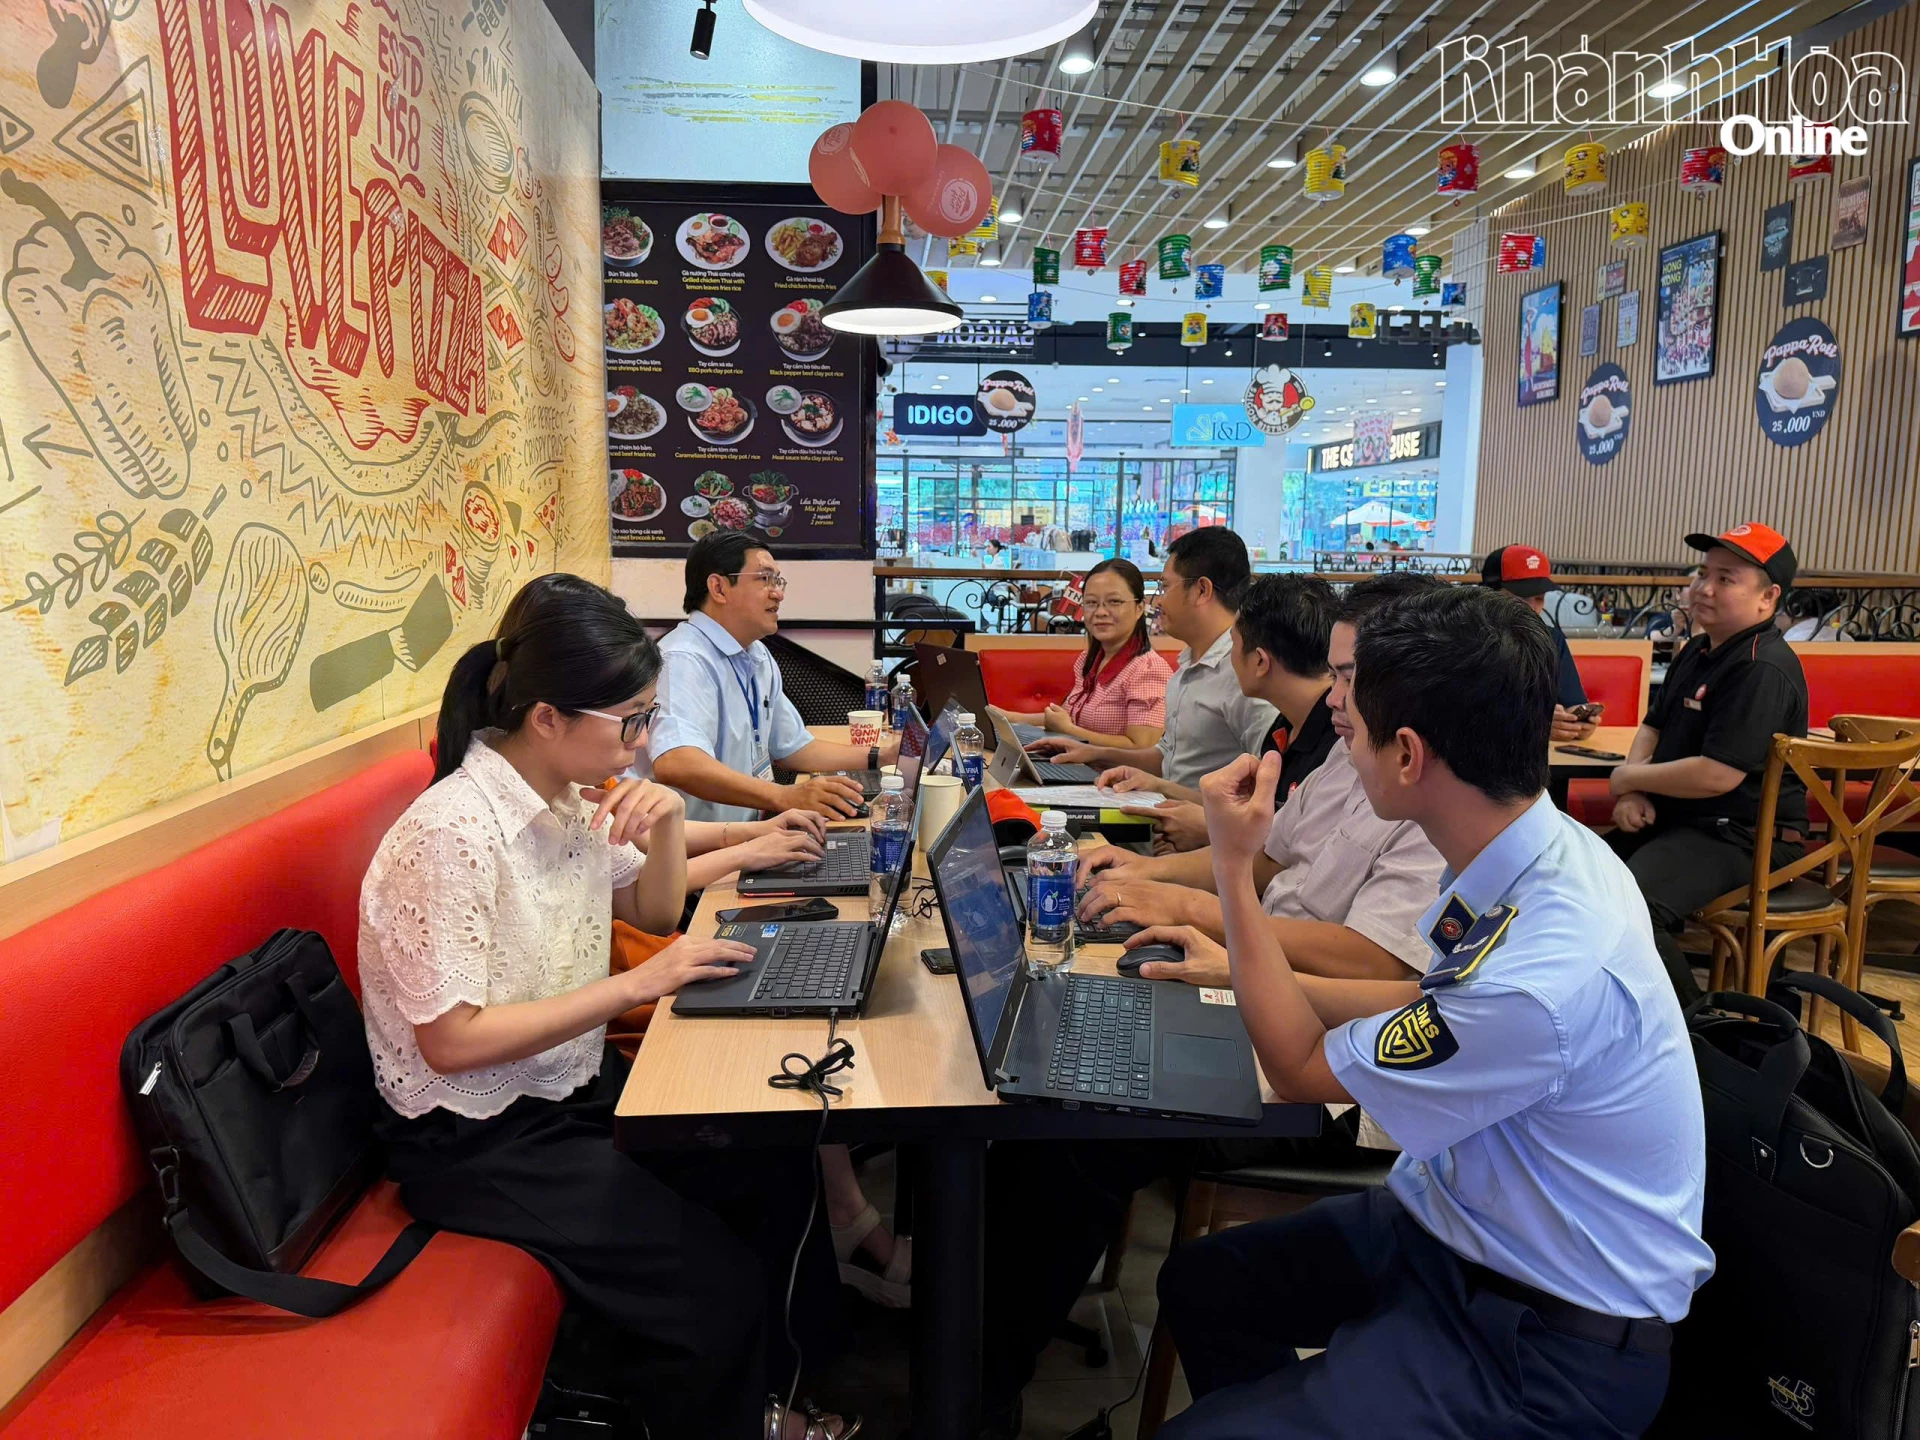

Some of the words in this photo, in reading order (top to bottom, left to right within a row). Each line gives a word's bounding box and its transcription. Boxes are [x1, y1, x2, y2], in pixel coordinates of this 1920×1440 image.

[378, 23, 423, 98] ESTD
[376, 73, 421, 172] 1958
[157, 0, 371, 376] LOVE
[362, 178, 487, 416] PIZZA
[1660, 272, 1682, 287] KONG
[1662, 259, 1682, 274] HONG
[908, 405, 973, 426] IDIGO
[1322, 446, 1340, 469] THE
[1416, 1002, 1440, 1040] DMS
